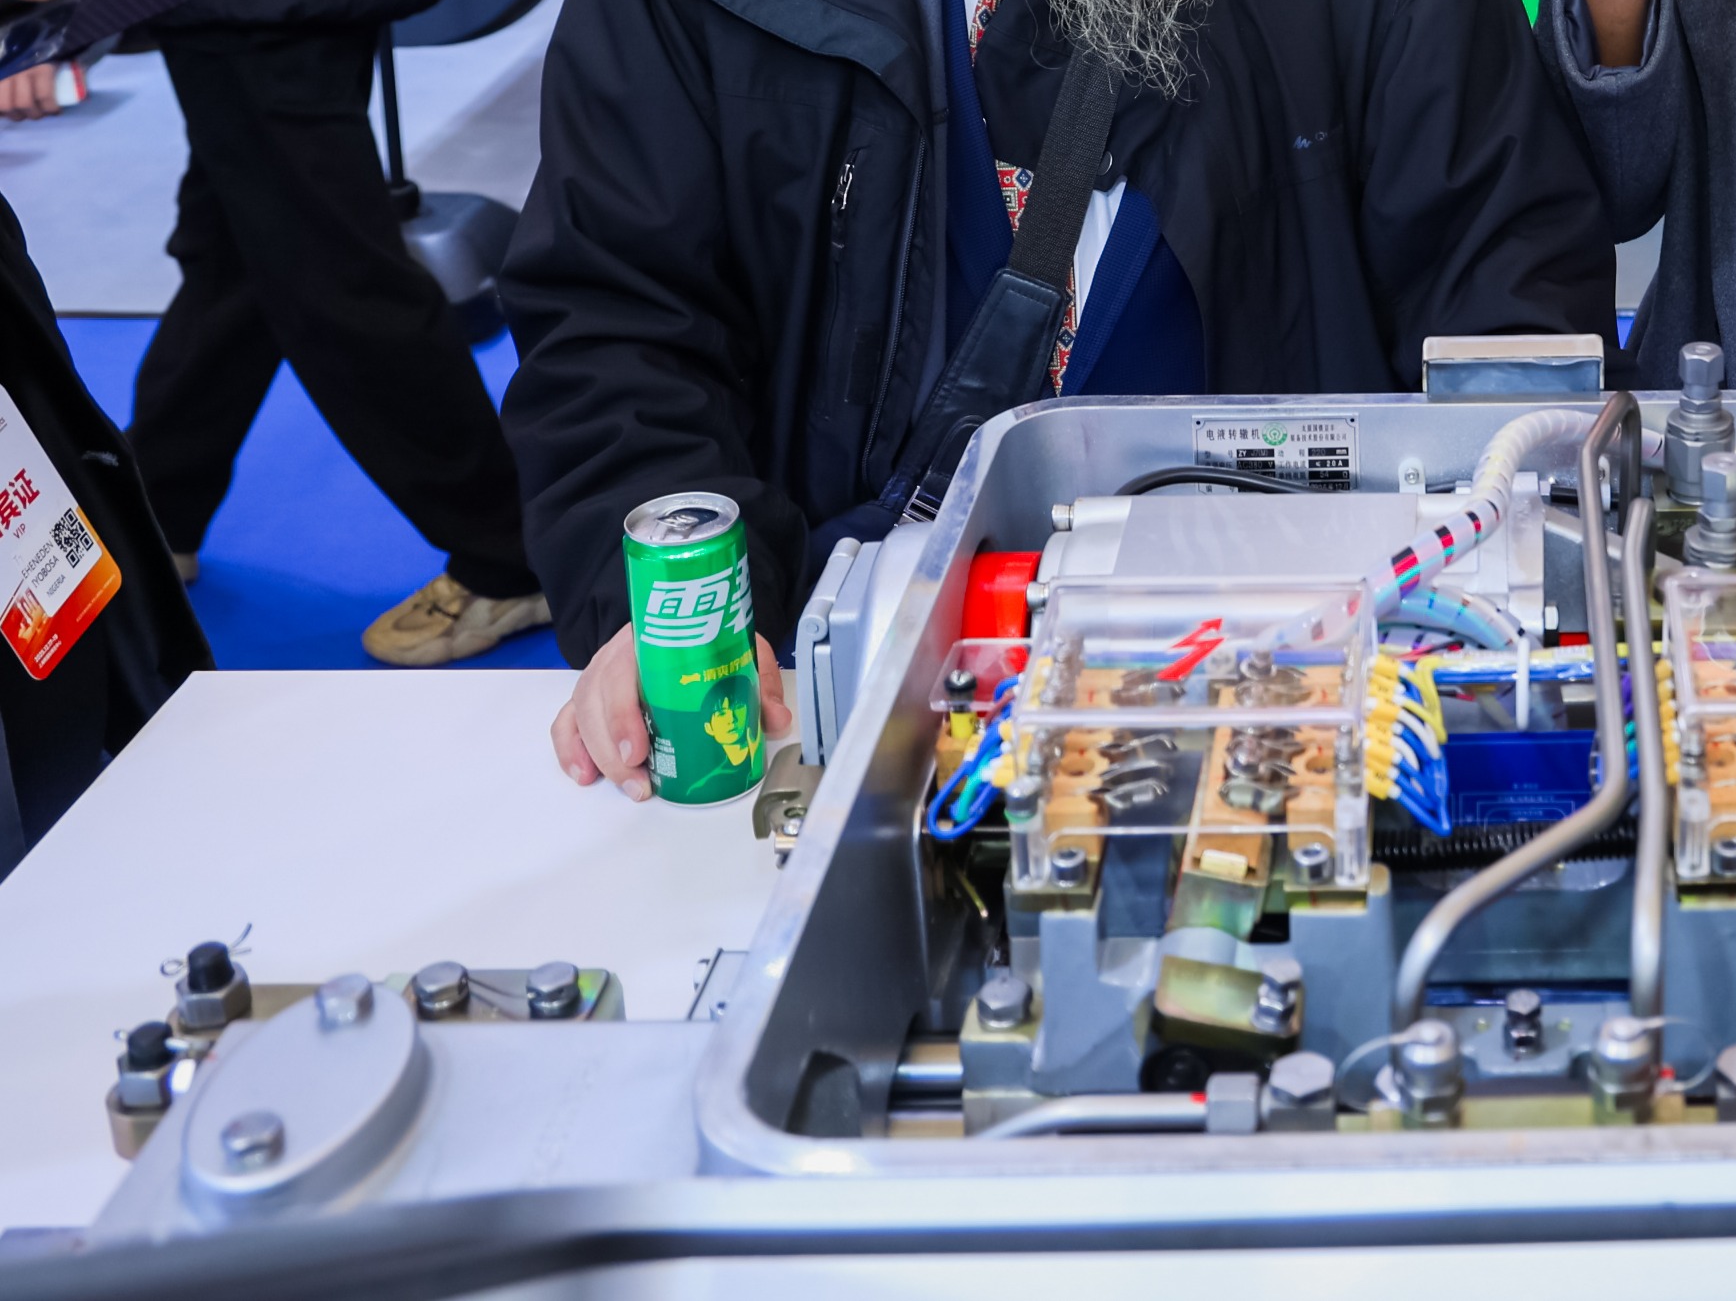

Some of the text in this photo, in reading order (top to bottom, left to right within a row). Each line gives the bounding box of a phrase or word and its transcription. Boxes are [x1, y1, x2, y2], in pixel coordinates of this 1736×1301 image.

[1206, 428, 1260, 441] 电液转辙机
[0, 467, 41, 539] 宾证
[13, 523, 27, 539] VIP
[21, 540, 55, 581] EHENEDEN
[32, 555, 60, 589] IYOBOSA
[46, 574, 67, 597] NIGERIA
